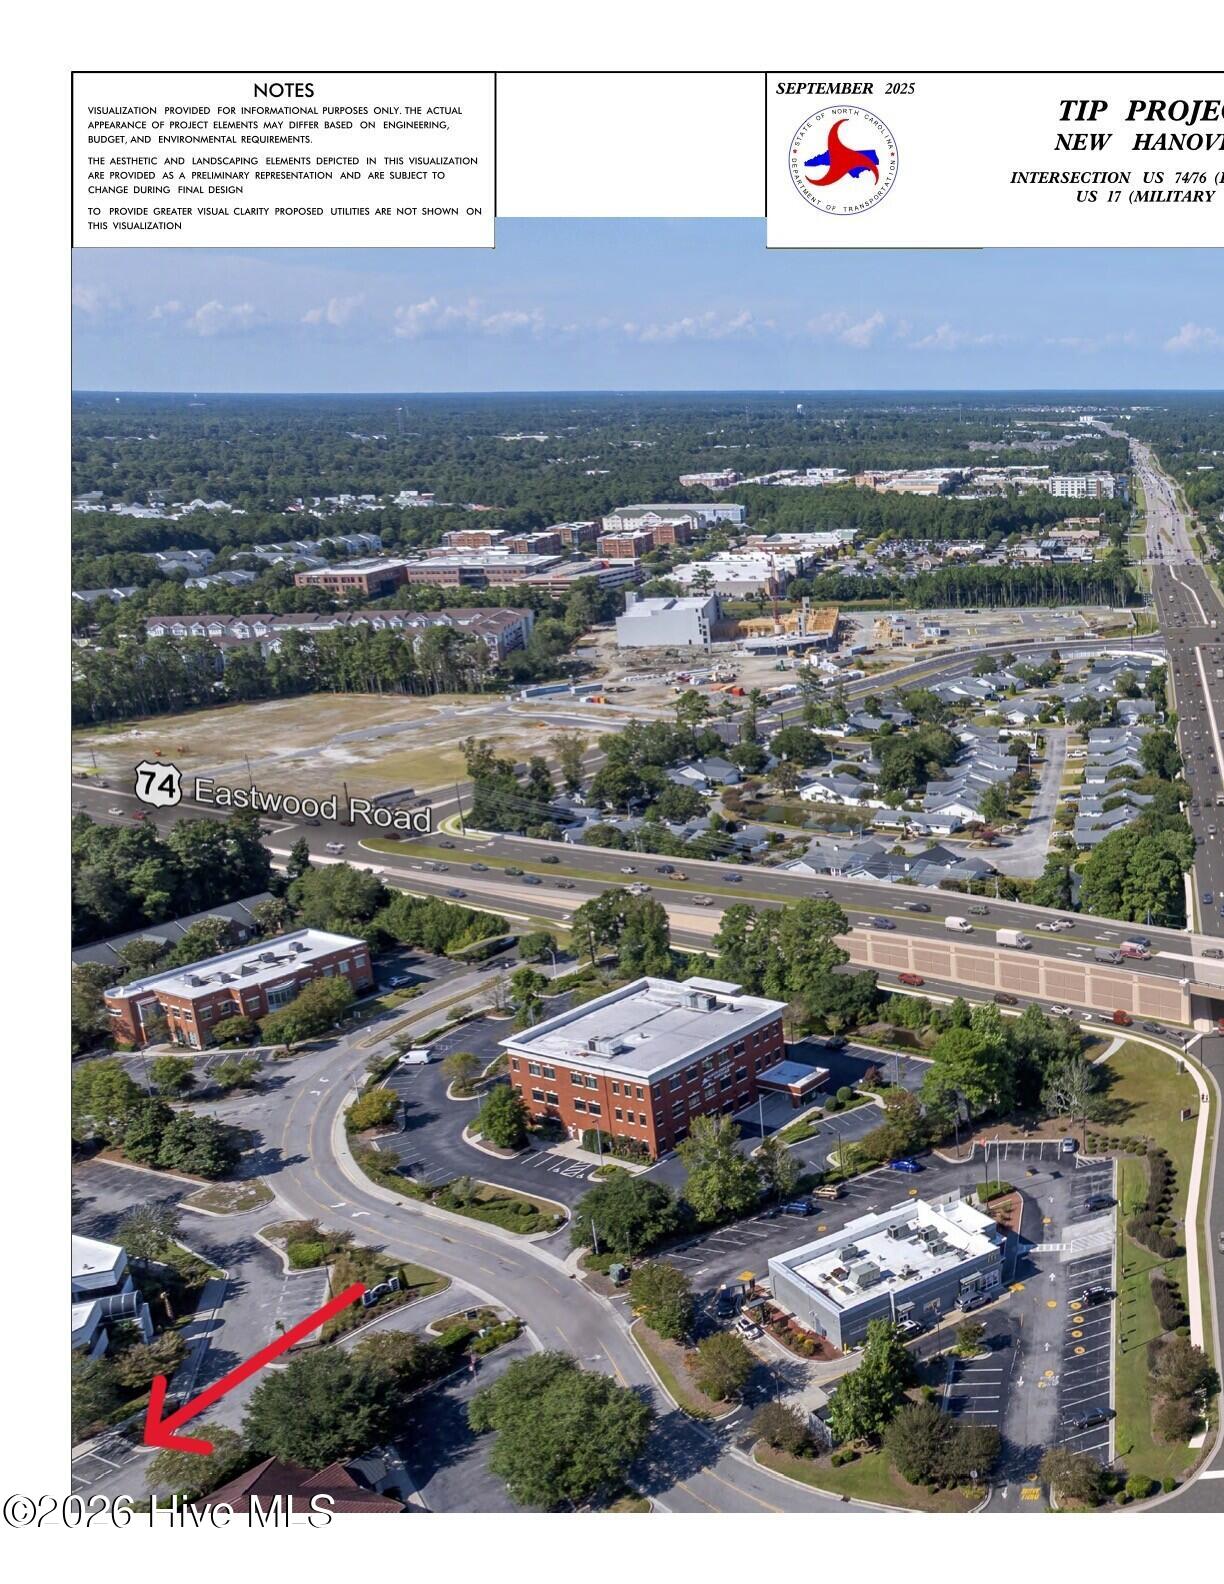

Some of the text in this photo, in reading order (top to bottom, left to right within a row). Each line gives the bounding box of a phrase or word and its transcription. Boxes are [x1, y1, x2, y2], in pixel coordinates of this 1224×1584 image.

[253, 82, 315, 98] NOTES
[775, 82, 916, 95] SEPTEMBER 2025
[87, 106, 463, 115] VISUALIZATION PROVIDED FOR INFORMATIONAL PURPOSES ONLY. THE ACTUAL
[1059, 99, 1109, 122] TIP
[87, 120, 450, 131] APPEARANCE OF PROJECT ELEMENTS MAY DIFFER BASED ON ENGINEERING,
[794, 108, 894, 150] STATE OF NORTH CAROLINA
[87, 135, 313, 145] BUDGET, AND ENVIRONMENTAL REQUIREMENTS.
[1053, 133, 1113, 151] NEW
[87, 156, 478, 166] THE AESTHETIC AND LANDSCAPING ELEMENTS DEPICTED IN THIS VISUALIZATION
[87, 171, 446, 180] ARE PROVIDED AS A PRELIMINARY REPRESENTATION AND ARE SUBJECT TO
[1009, 171, 1132, 184] INTERSECTION
[1143, 171, 1165, 184] US
[1175, 171, 1207, 184] 74/76
[87, 185, 244, 194] CHANGE DURING FINAL DESIGN
[791, 157, 896, 212] DEPARTMENT OF TRANSPORTATION
[1076, 190, 1098, 203] US
[1107, 190, 1122, 203] 17
[1128, 190, 1217, 205] (MILITARY
[87, 207, 482, 216] TO PROVIDE GREATER VISUAL CLARITY PROPOSED UTILITIES ARE NOT SHOWN ON
[87, 221, 182, 230] THIS VISUALIZATION
